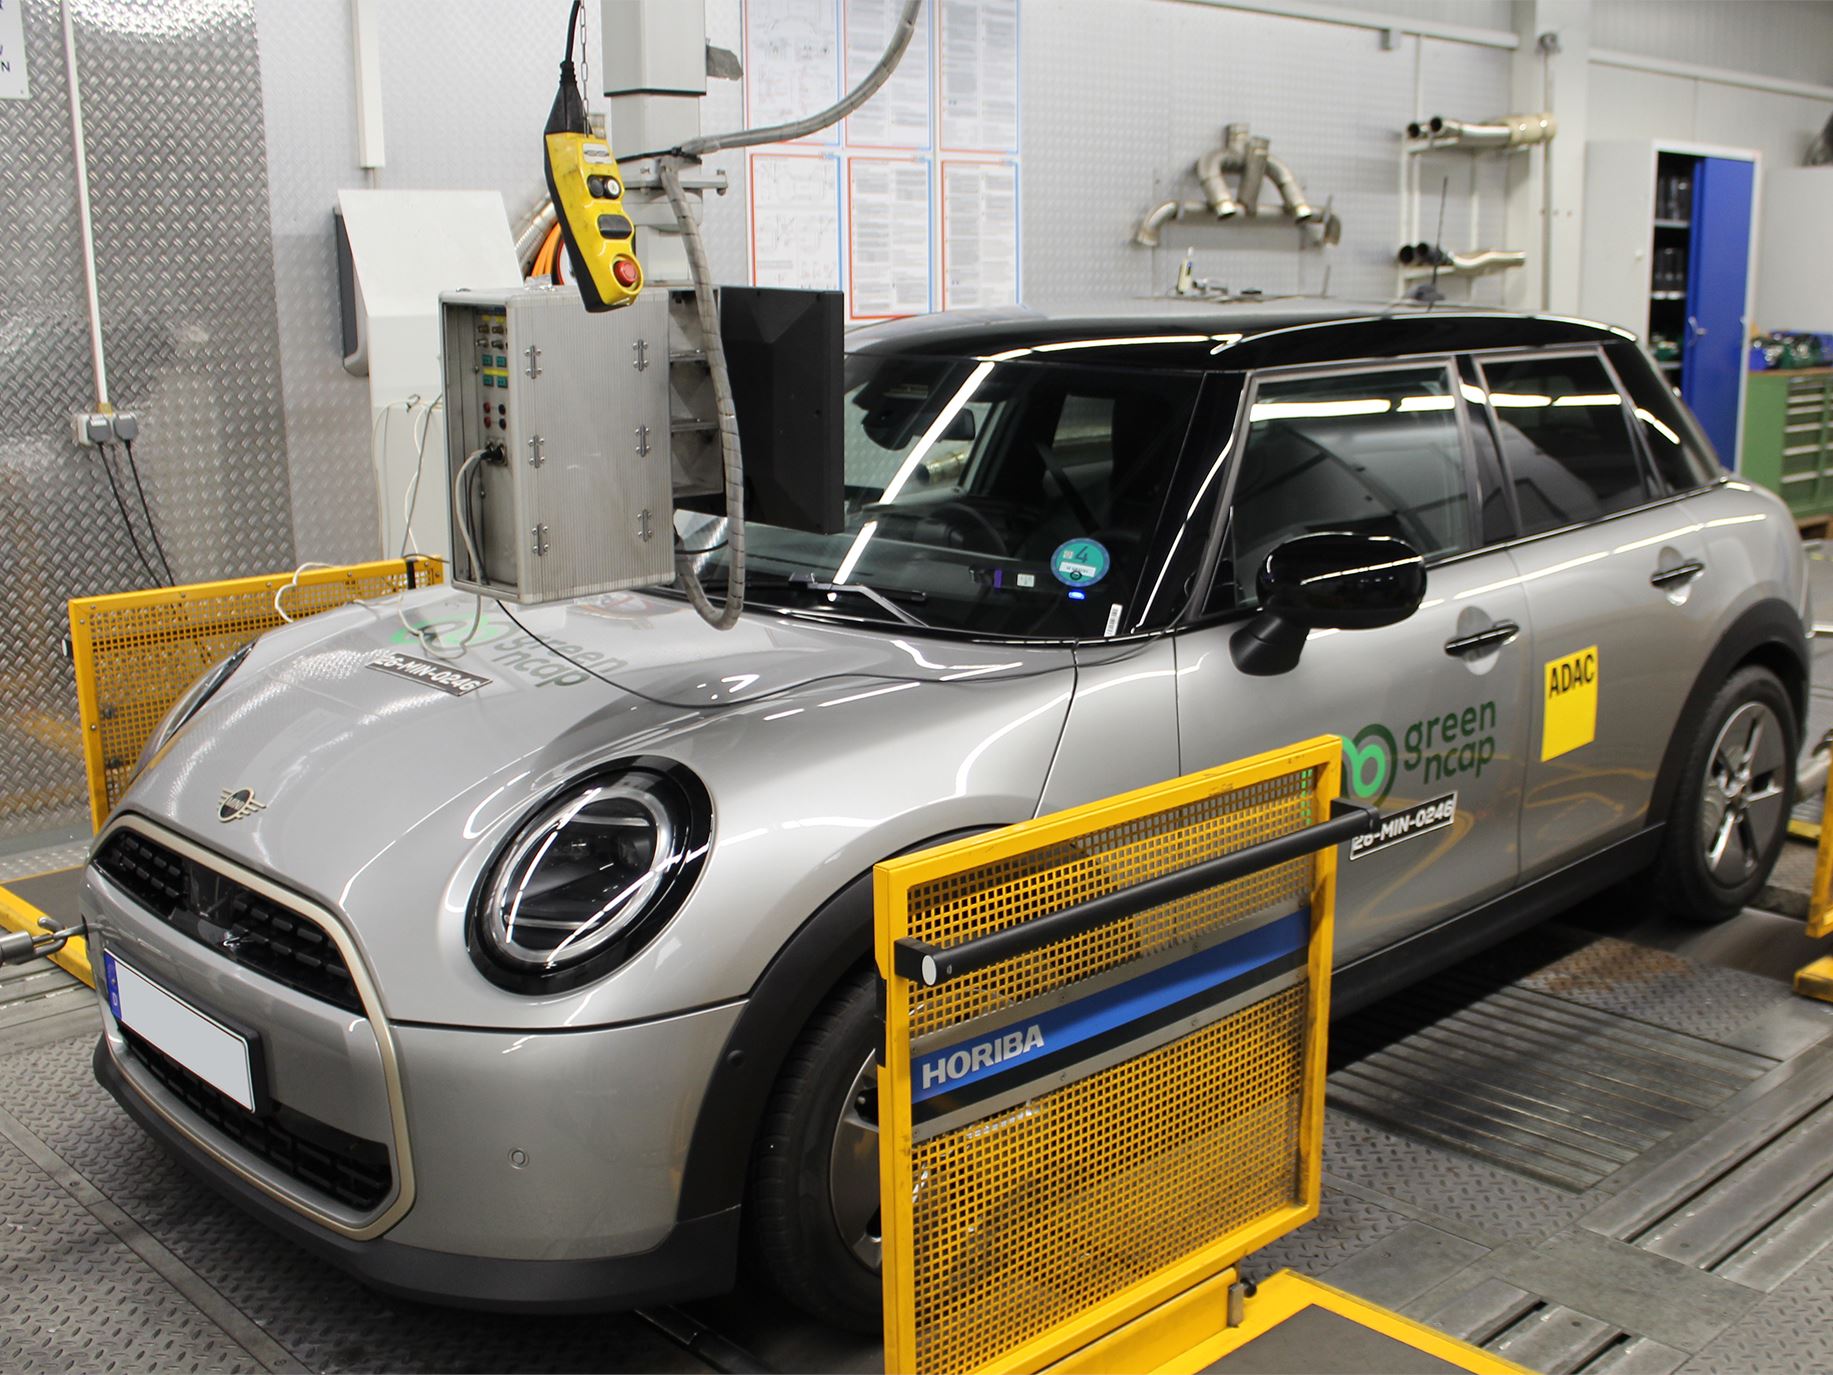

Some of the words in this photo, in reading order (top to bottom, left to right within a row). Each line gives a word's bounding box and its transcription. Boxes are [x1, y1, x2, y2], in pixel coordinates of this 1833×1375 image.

[1075, 546, 1089, 563] 4
[491, 650, 592, 688] ncap
[1548, 653, 1595, 699] ADAC
[1403, 700, 1496, 772] green
[1423, 735, 1496, 785] ncap
[922, 1024, 1045, 1090] HORIBA
